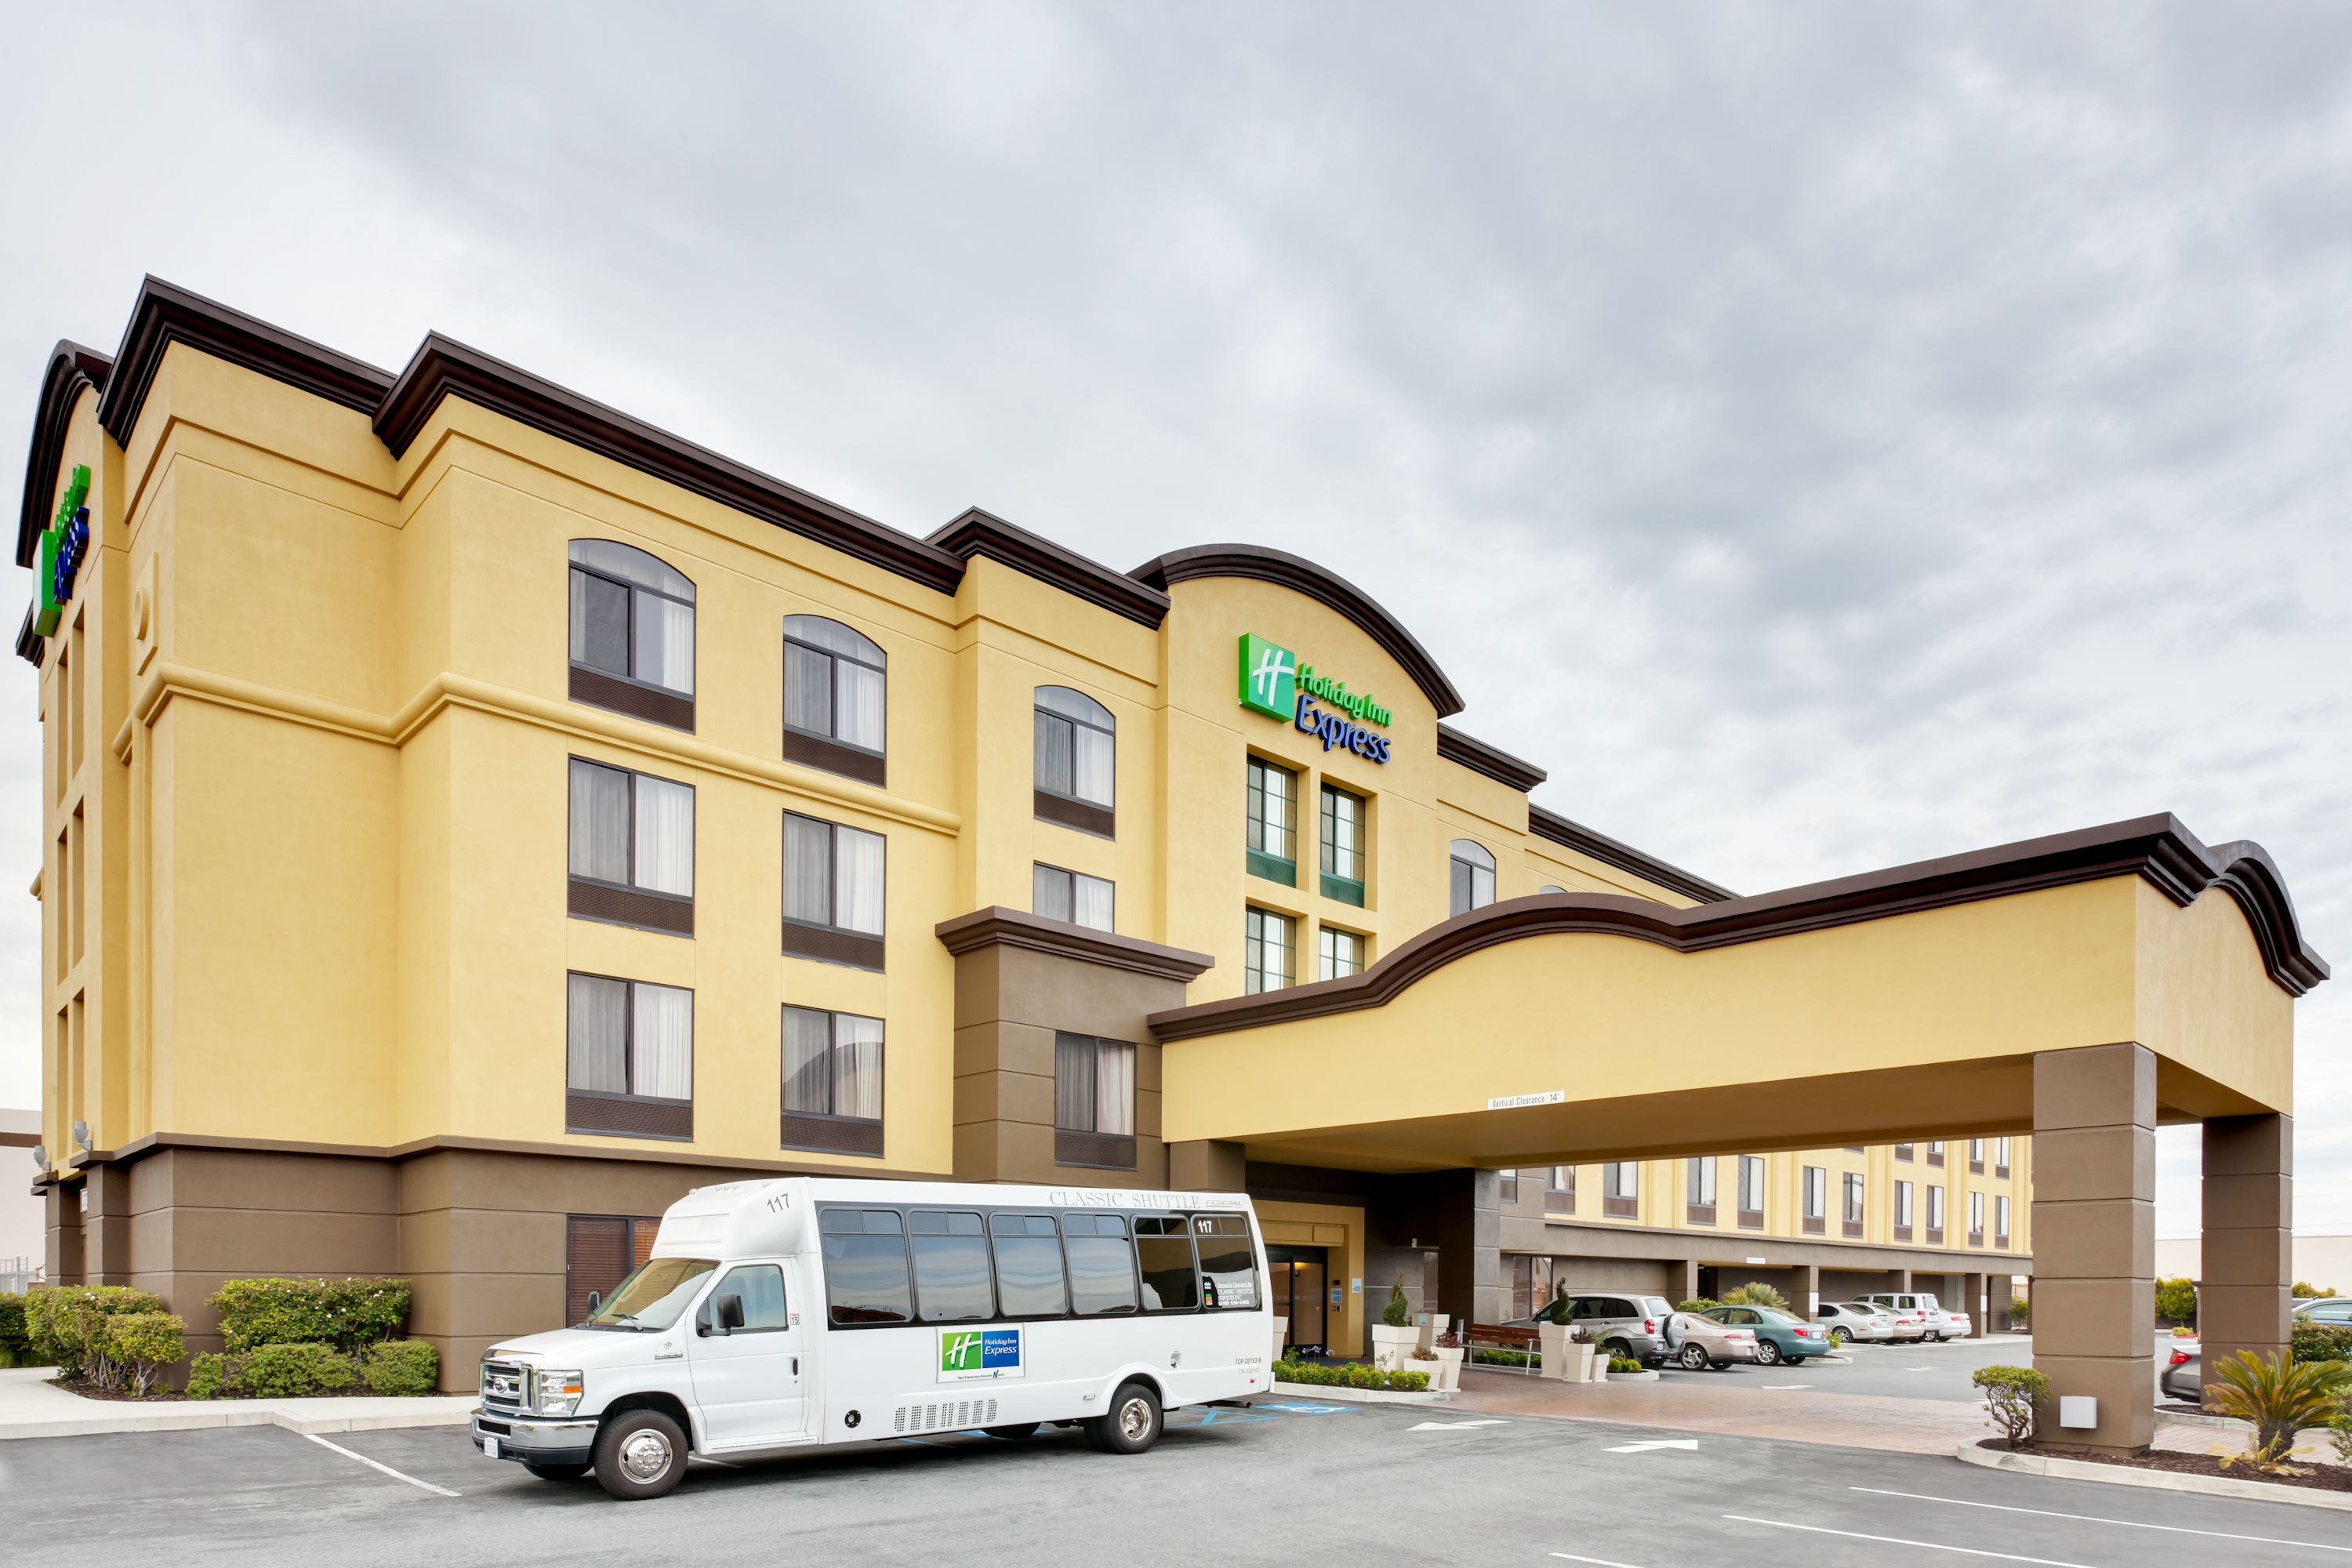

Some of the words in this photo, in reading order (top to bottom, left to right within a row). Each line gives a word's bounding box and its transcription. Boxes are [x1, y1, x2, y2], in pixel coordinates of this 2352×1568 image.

[1295, 662, 1365, 720] Holiday
[1363, 694, 1392, 728] Inn
[1295, 694, 1391, 764] Express
[1492, 1098, 1515, 1108] Vertical
[1516, 1096, 1545, 1105] Clearance
[767, 1192, 789, 1213] 117
[1050, 1191, 1123, 1207] CLASSIC
[1131, 1193, 1201, 1209] SHUTTLE
[1197, 1220, 1212, 1233] 117
[985, 1345, 1017, 1356] Express
